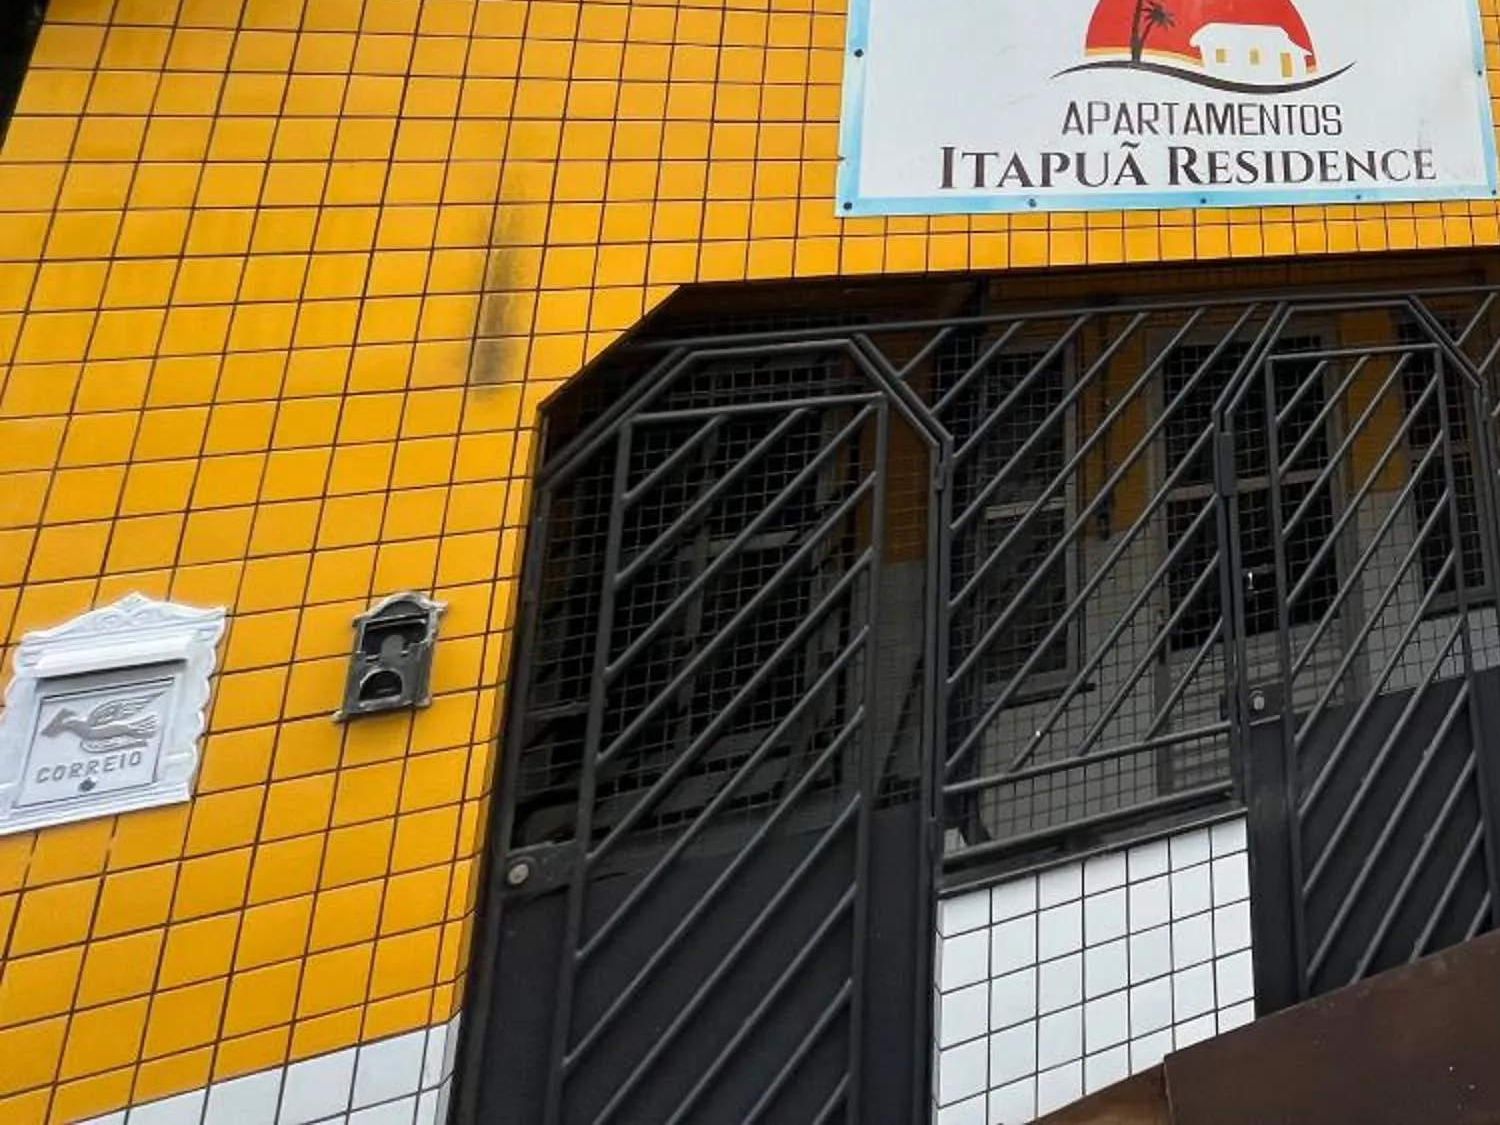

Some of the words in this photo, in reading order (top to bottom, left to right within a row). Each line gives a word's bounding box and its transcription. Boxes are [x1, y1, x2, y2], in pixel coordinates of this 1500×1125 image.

[1062, 101, 1343, 136] APARTAMENTOS
[939, 141, 1150, 189] ITAPUÃ
[1168, 146, 1437, 186] RESIDENCE
[35, 750, 142, 784] CORREIO
